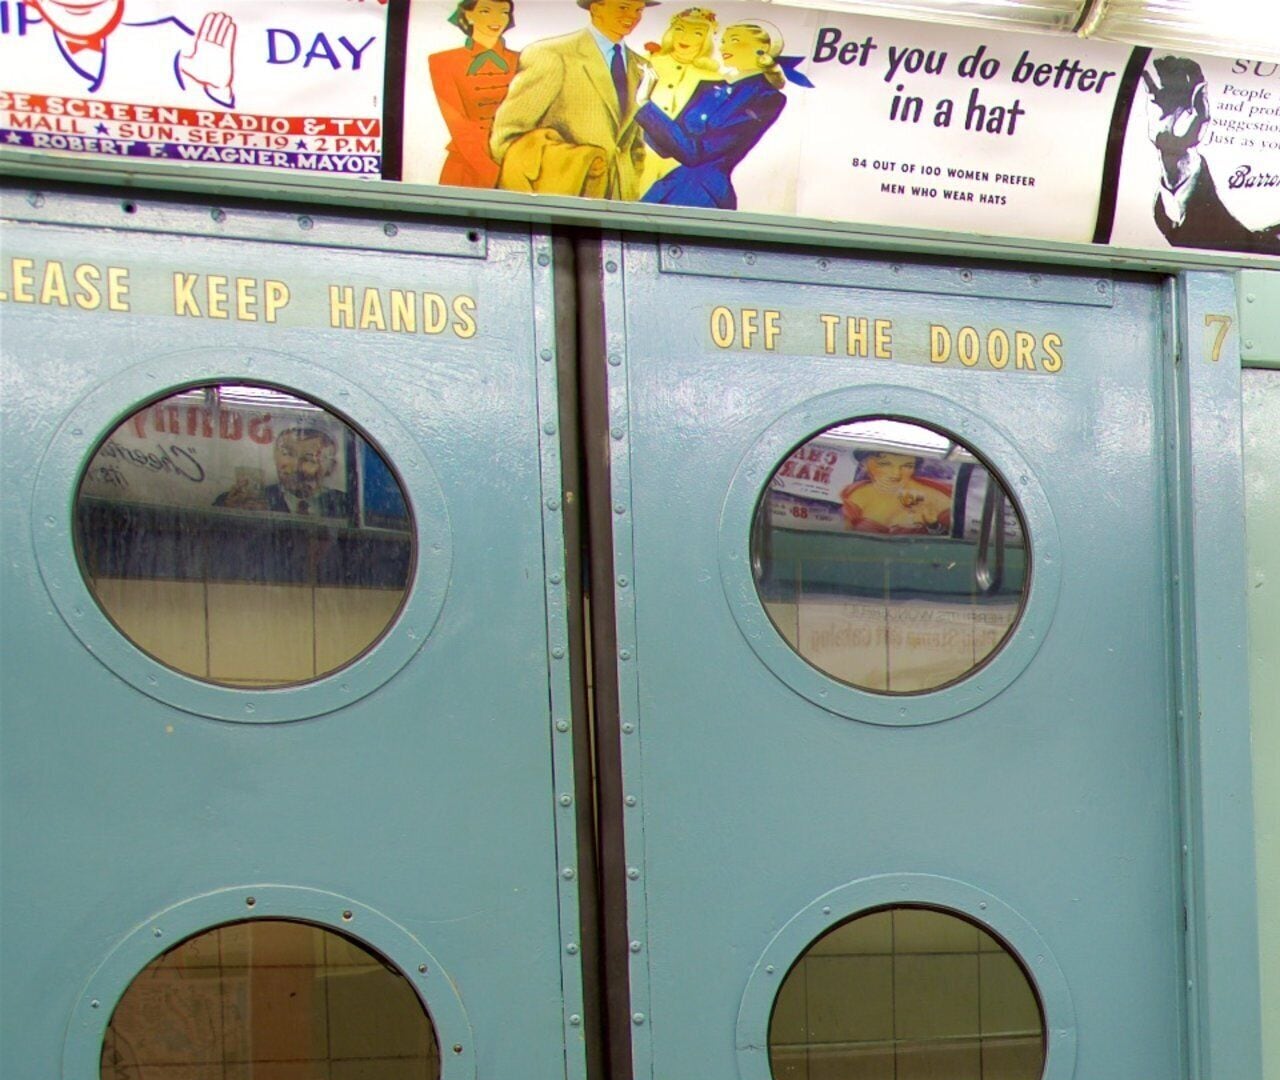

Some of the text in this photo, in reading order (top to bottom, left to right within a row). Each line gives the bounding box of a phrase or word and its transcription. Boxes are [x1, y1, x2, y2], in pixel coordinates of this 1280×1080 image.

[265, 28, 376, 70] DAY
[812, 27, 1116, 94] Bet you do better
[889, 84, 1026, 136] in a hat
[1216, 100, 1244, 112] and
[1222, 84, 1272, 100] People
[9, 113, 381, 154] MALL SUN. SEPT. 19 2 P.M.
[46, 97, 376, 135] SCREEN, RADIO & TV
[31, 133, 135, 155] ROBERT
[147, 143, 168, 157] F.
[297, 155, 380, 173] MAYOR
[1205, 131, 1235, 146] Just
[852, 157, 1036, 187] 84 OUT OF 100 WOMEN PREFER
[880, 183, 1007, 206] MEN WHO WEAR HATS
[173, 271, 291, 323] KEEP
[329, 284, 477, 339] HANDS
[710, 305, 1063, 373] OFF THE DOORS
[1205, 314, 1232, 362] 7
